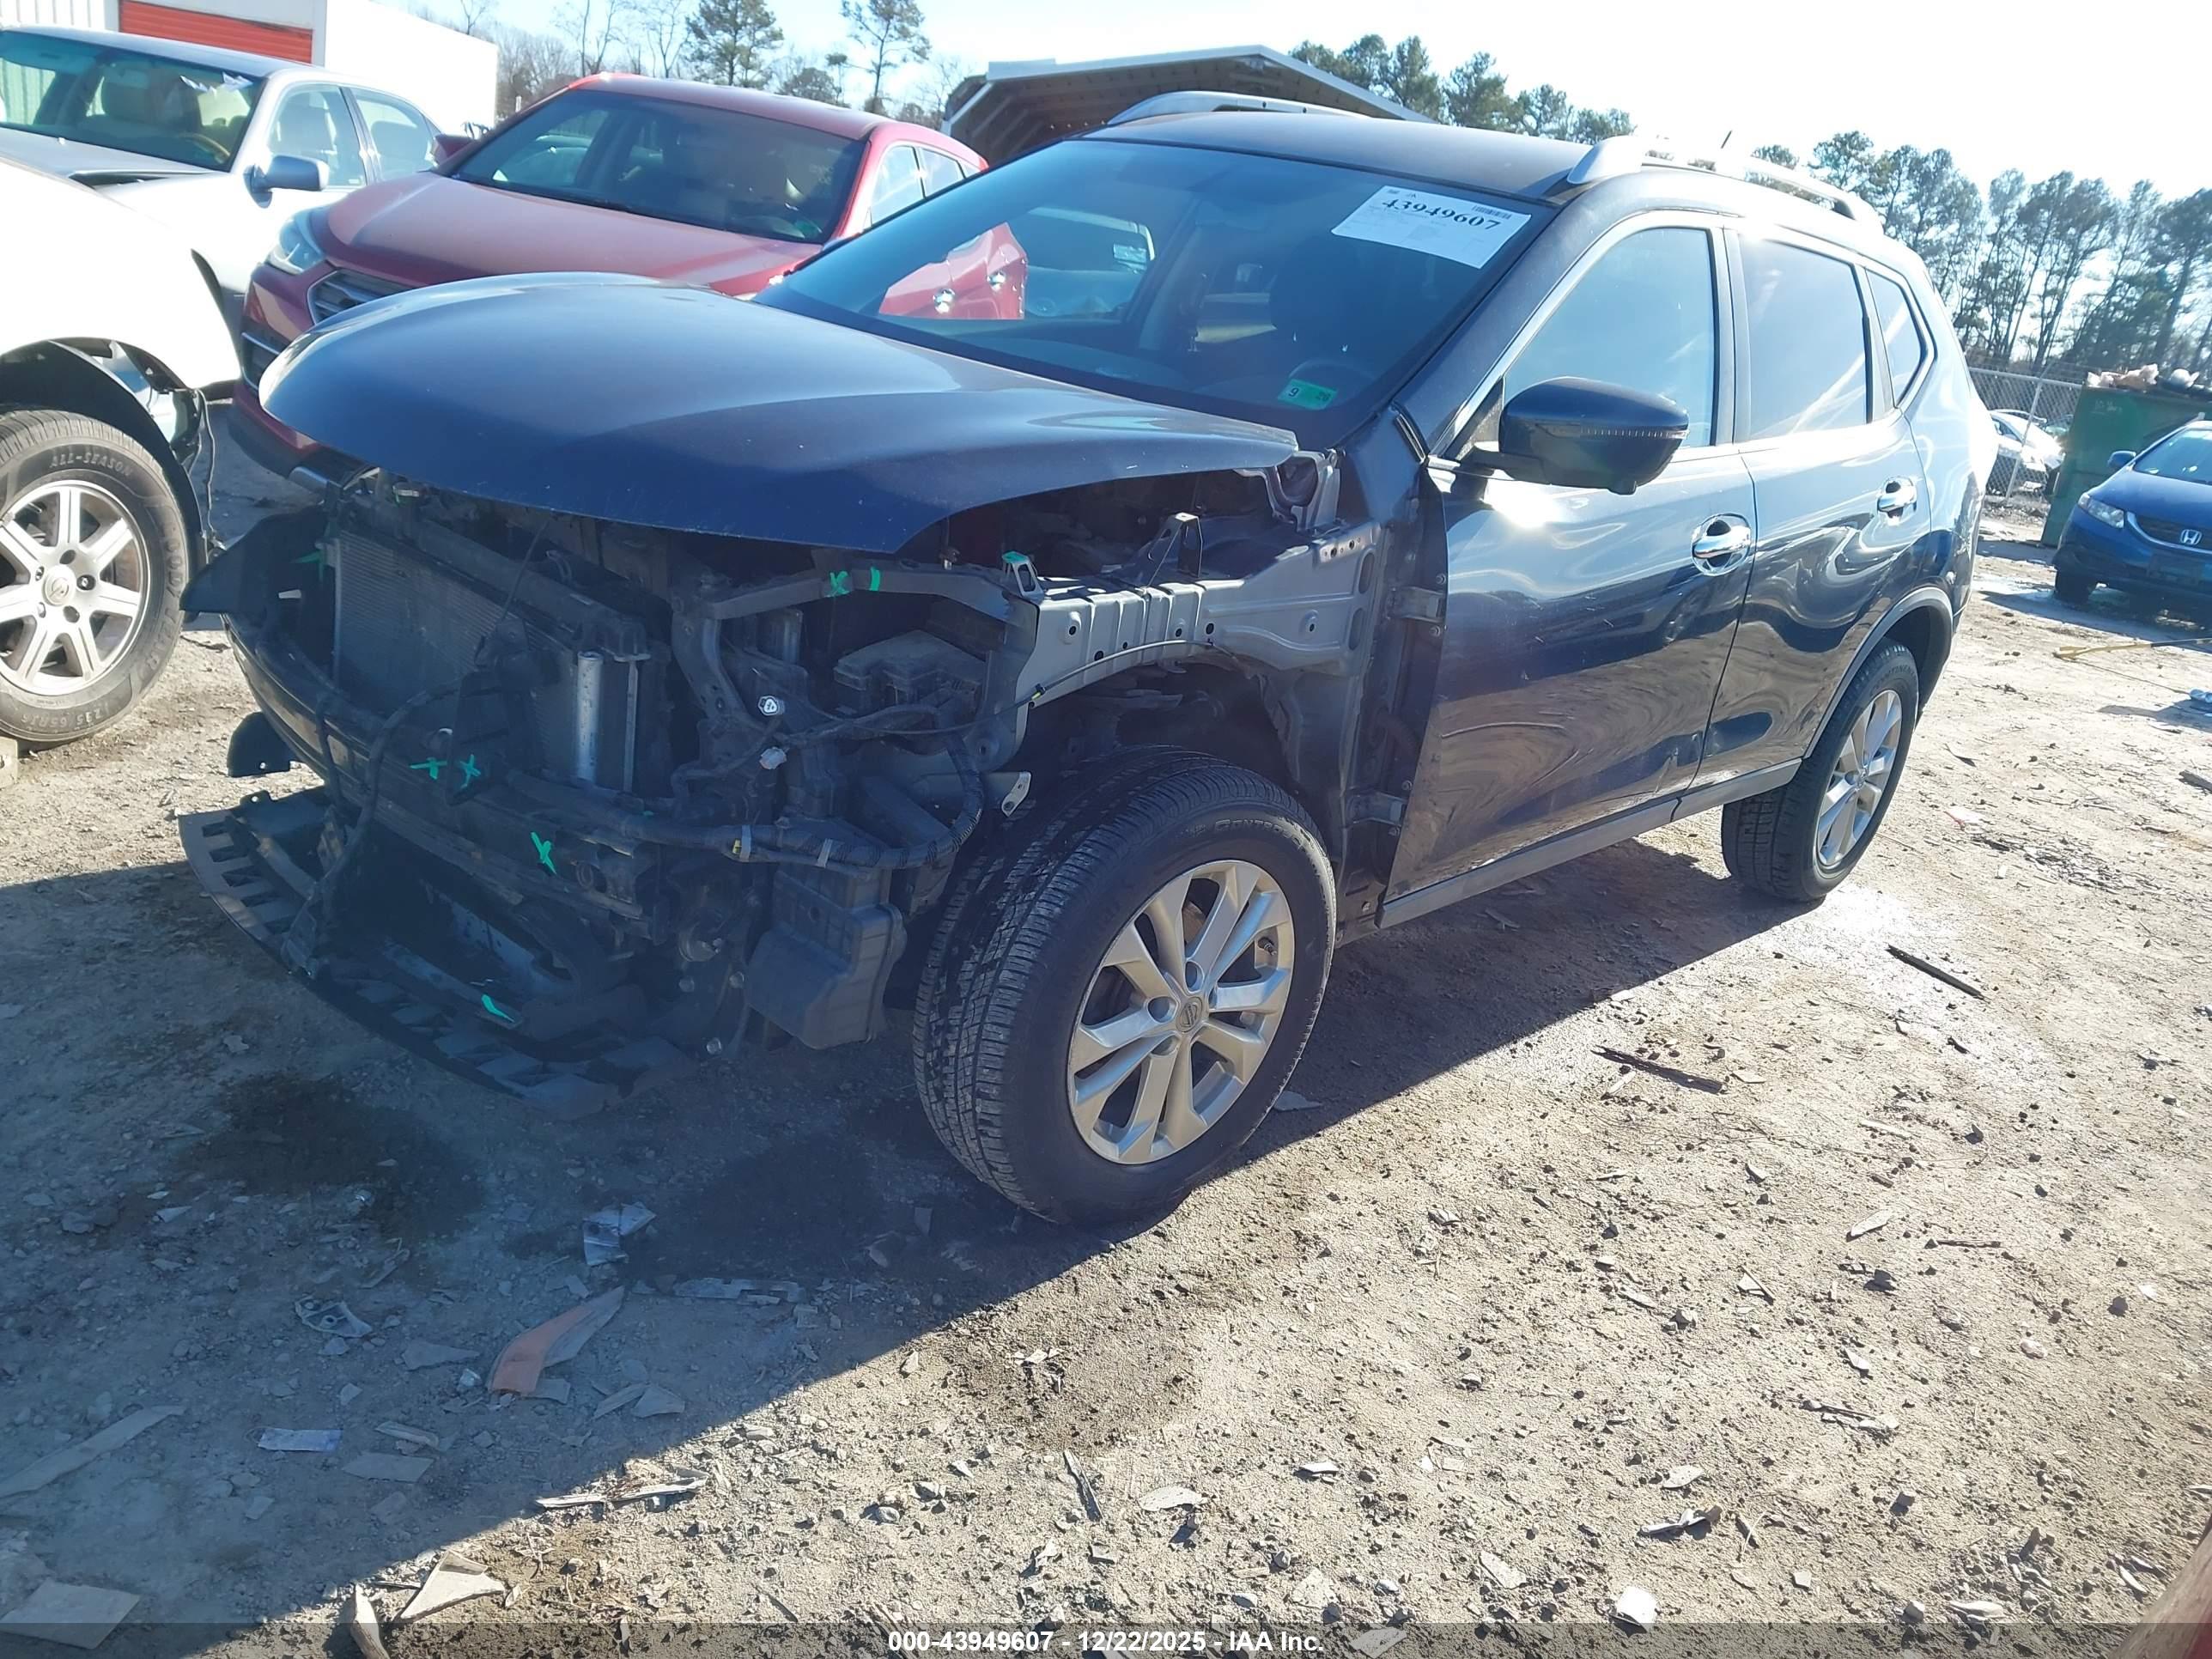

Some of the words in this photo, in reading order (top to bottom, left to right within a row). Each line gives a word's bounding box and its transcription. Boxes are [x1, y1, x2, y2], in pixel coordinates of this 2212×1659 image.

[1382, 198, 1502, 230] 43949607
[1288, 387, 1299, 397] 9
[49, 452, 133, 477] ALL-SEASON
